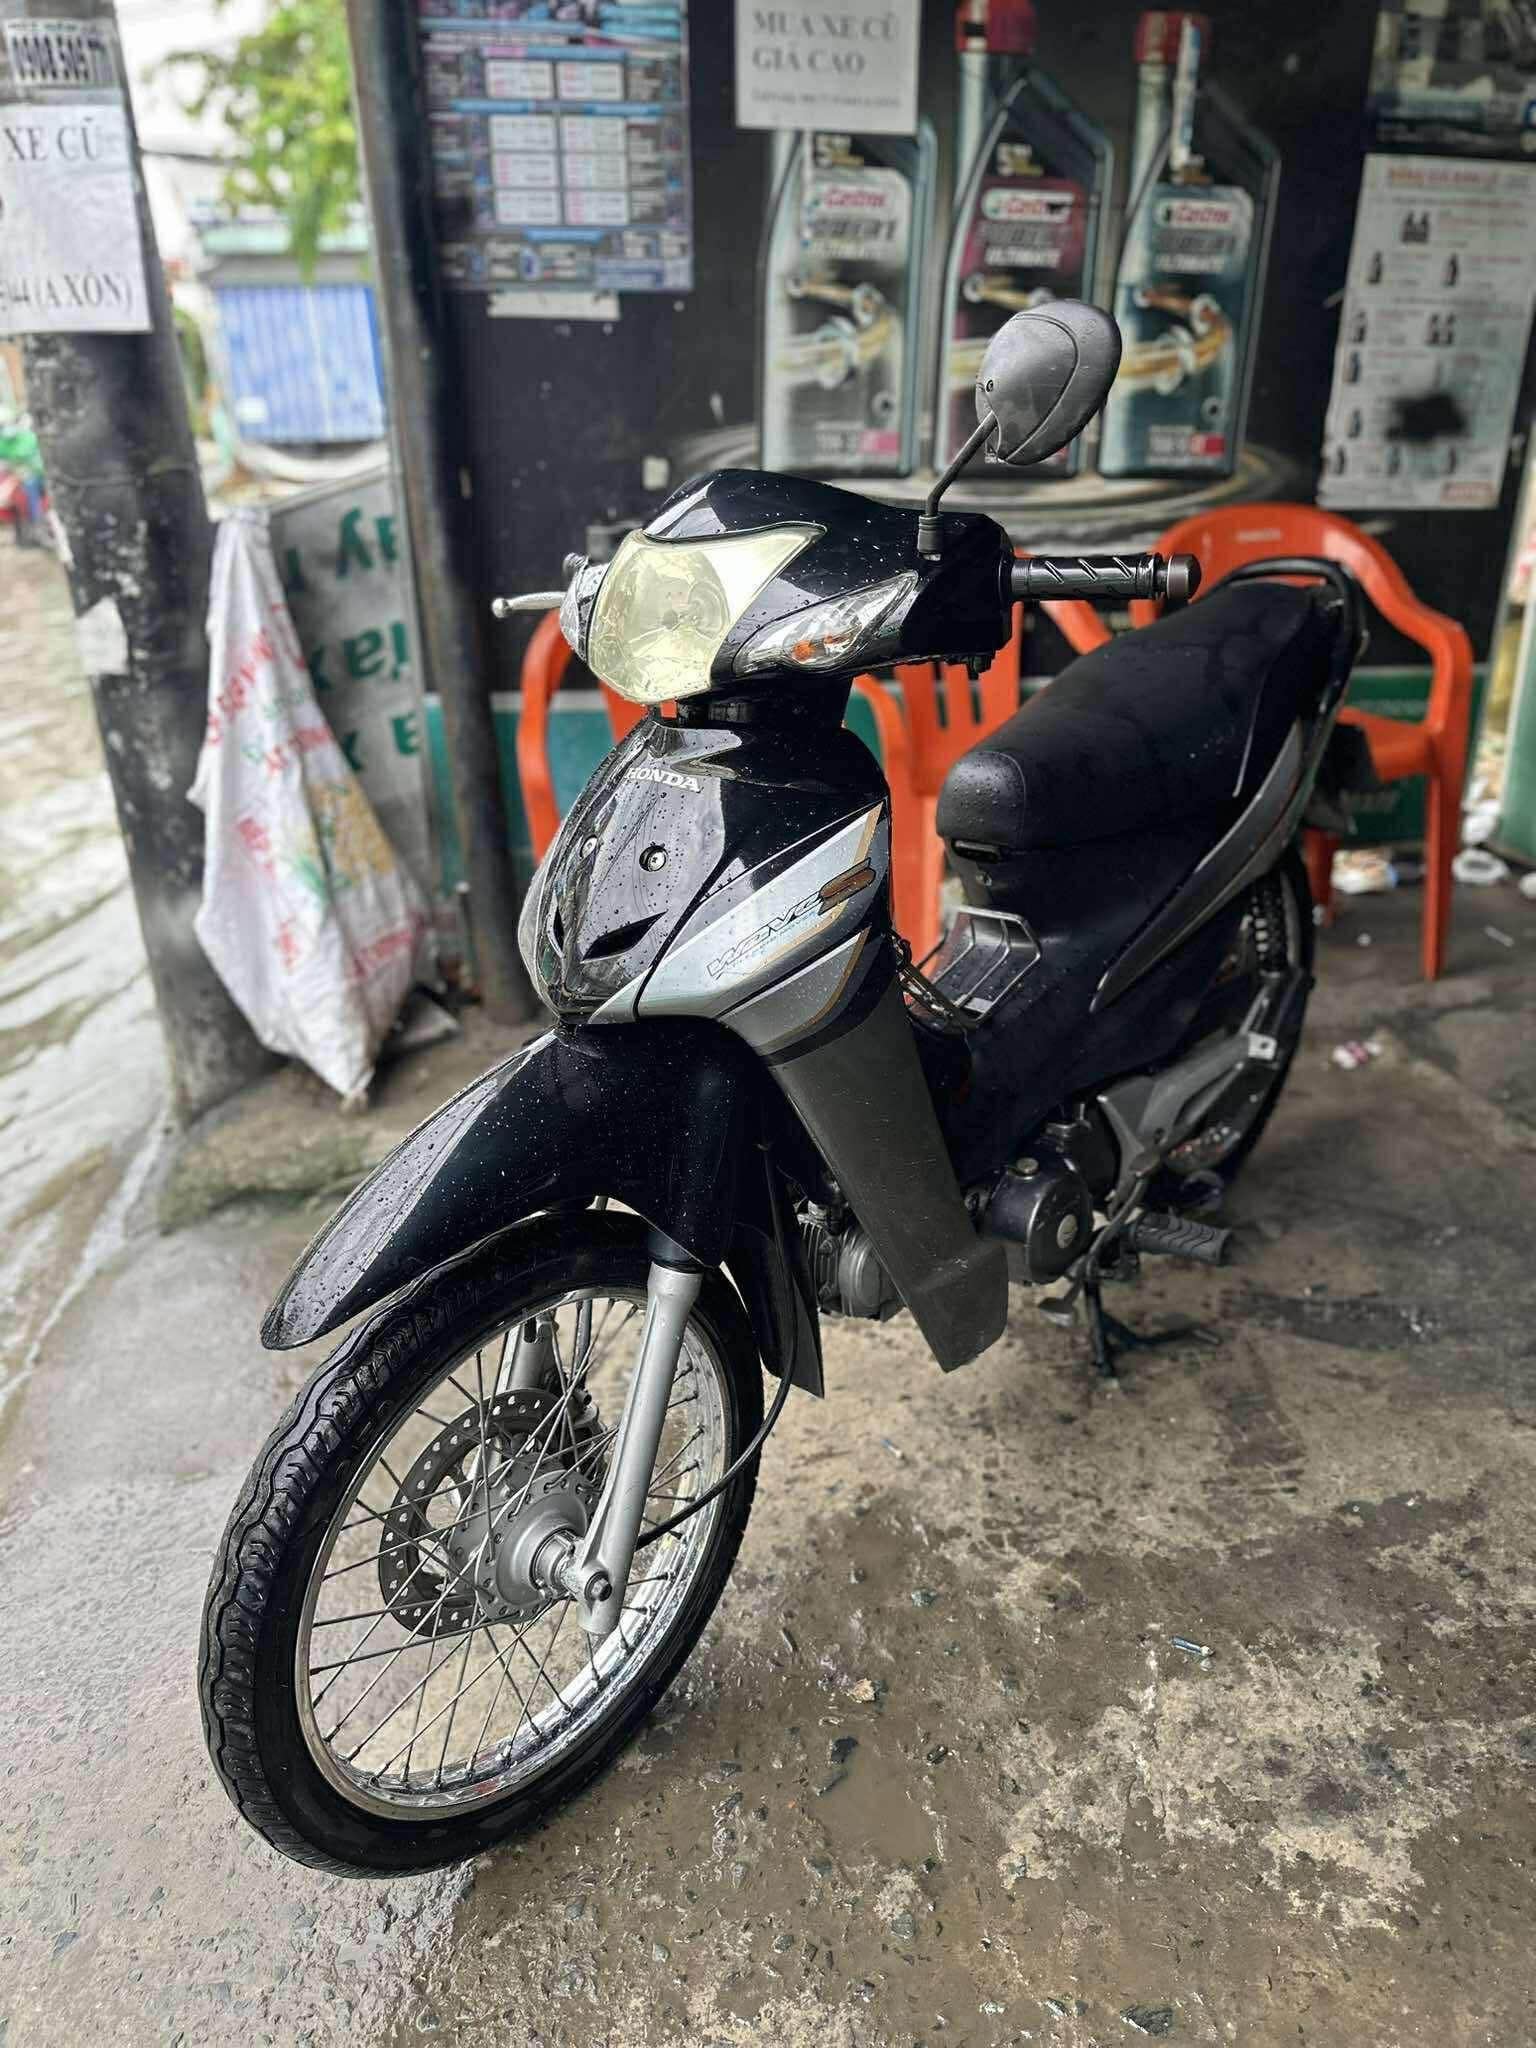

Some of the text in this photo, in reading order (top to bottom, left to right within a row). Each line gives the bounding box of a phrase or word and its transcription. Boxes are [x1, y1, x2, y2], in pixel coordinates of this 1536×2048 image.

[752, 11, 815, 37] MUA
[821, 14, 853, 39] XE
[807, 48, 866, 75] CAO
[3, 126, 48, 161] XE
[624, 766, 701, 793] HONDA
